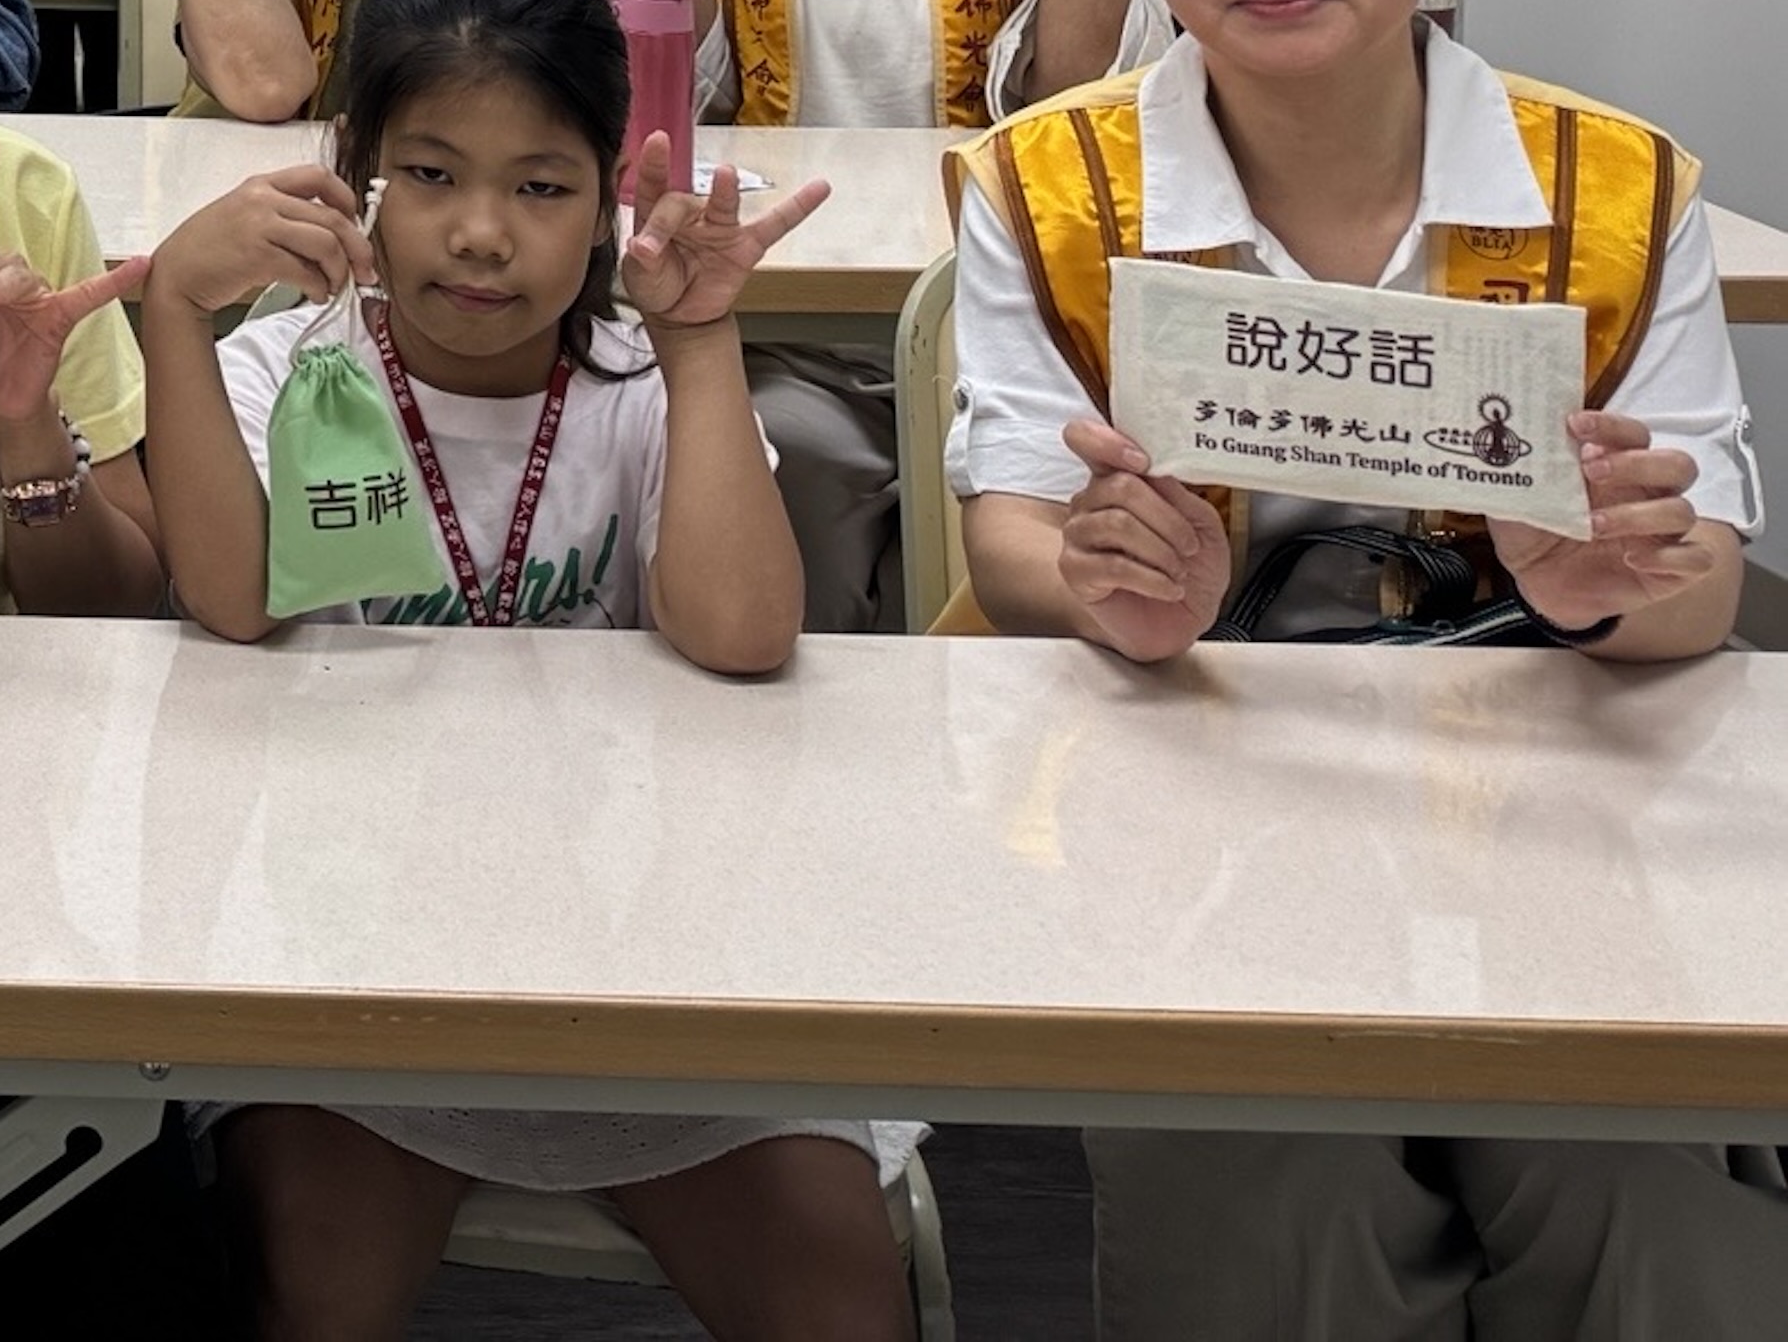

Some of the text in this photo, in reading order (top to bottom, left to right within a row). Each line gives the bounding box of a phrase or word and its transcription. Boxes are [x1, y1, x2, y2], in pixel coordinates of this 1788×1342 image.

[1225, 312, 1436, 389] 說好話
[1194, 400, 1412, 445] 多倫多佛光山
[1194, 432, 1534, 488] Fo Guang Shan Temple of Toronto
[304, 466, 411, 530] 吉祥
